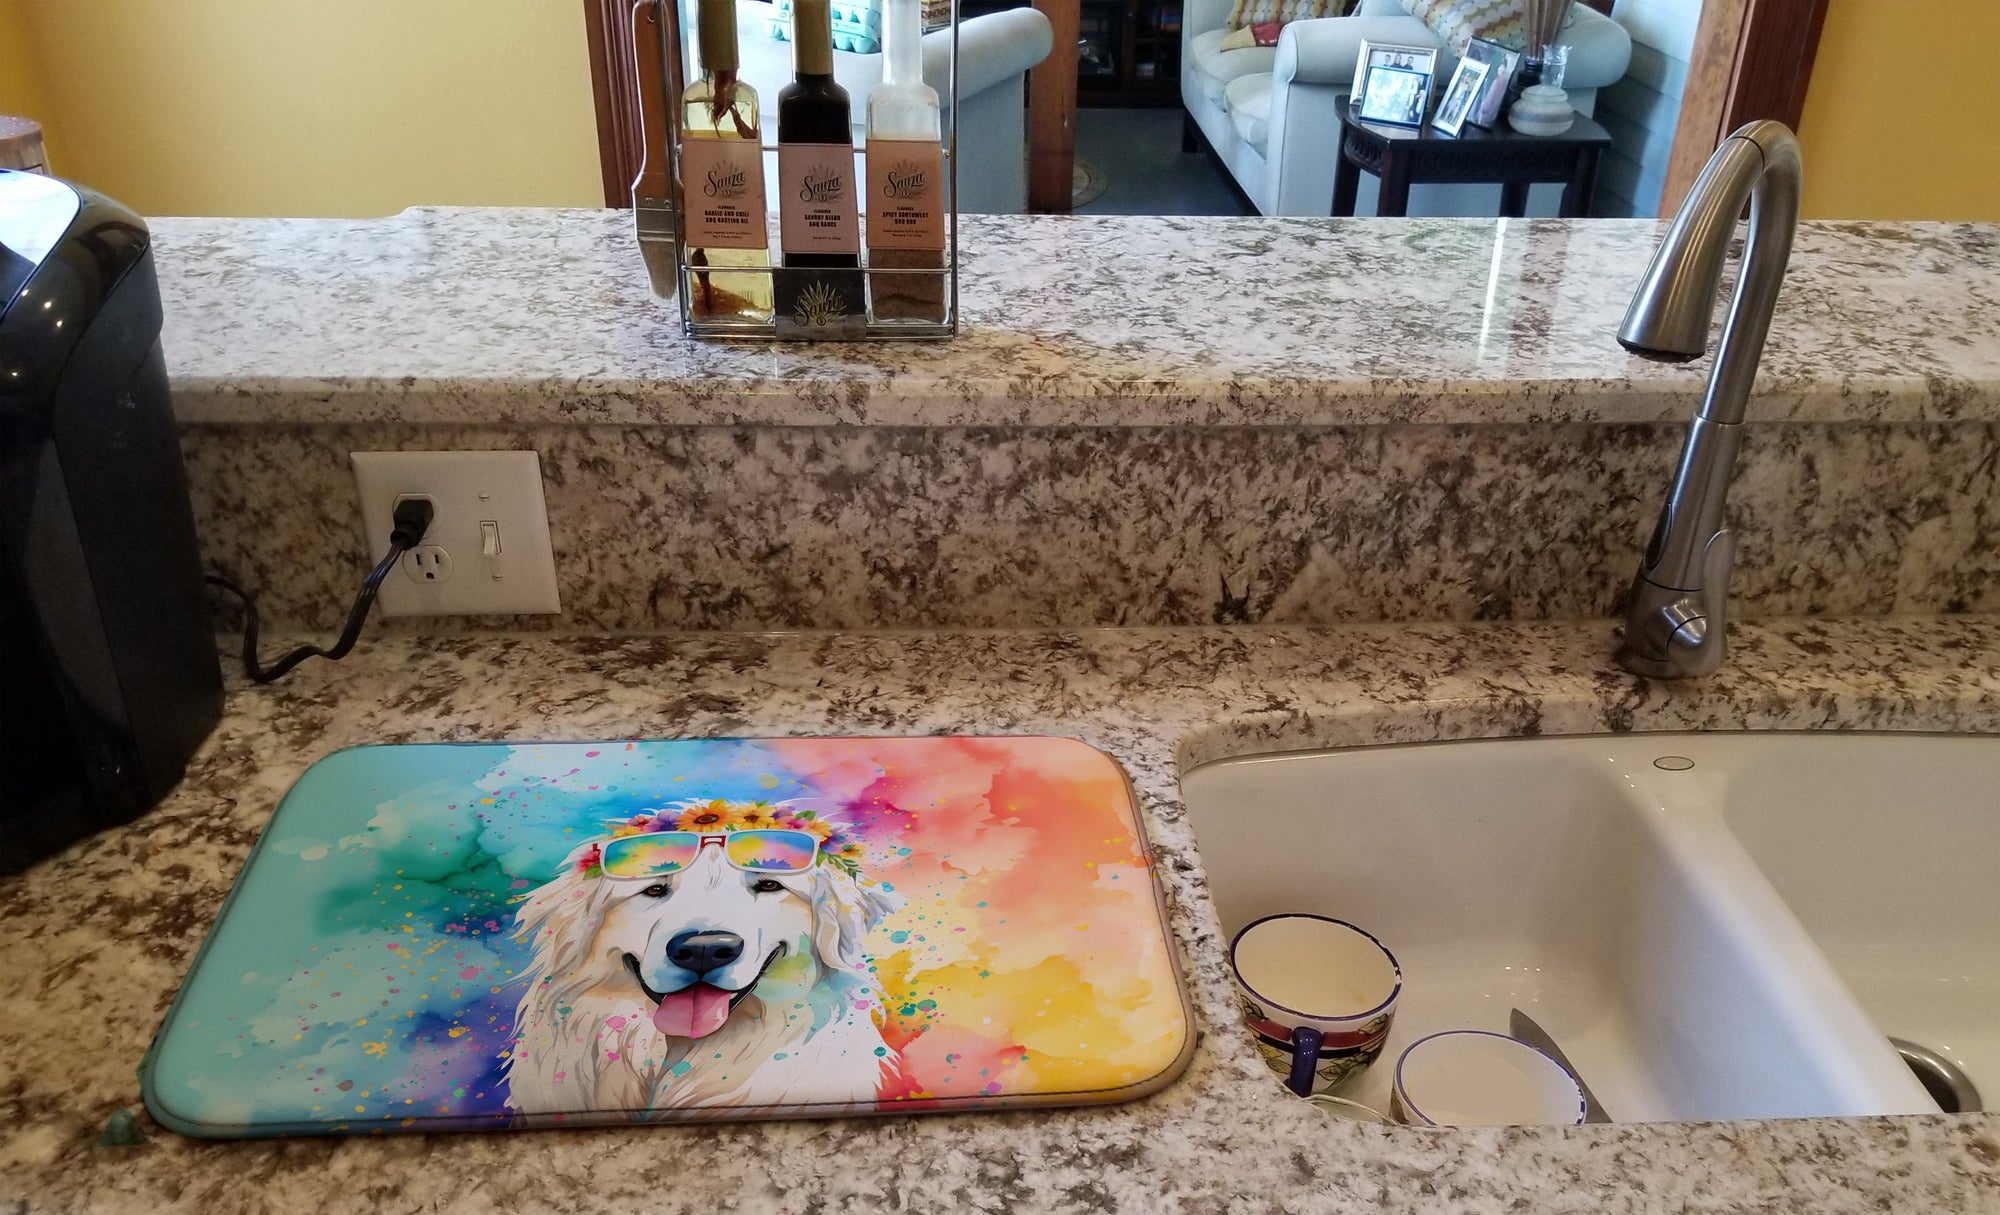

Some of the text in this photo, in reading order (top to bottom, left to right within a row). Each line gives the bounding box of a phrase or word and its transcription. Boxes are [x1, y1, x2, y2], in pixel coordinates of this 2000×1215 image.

[704, 170, 745, 197] Sauza
[800, 175, 841, 202] Sauza
[884, 171, 924, 198] Sauza
